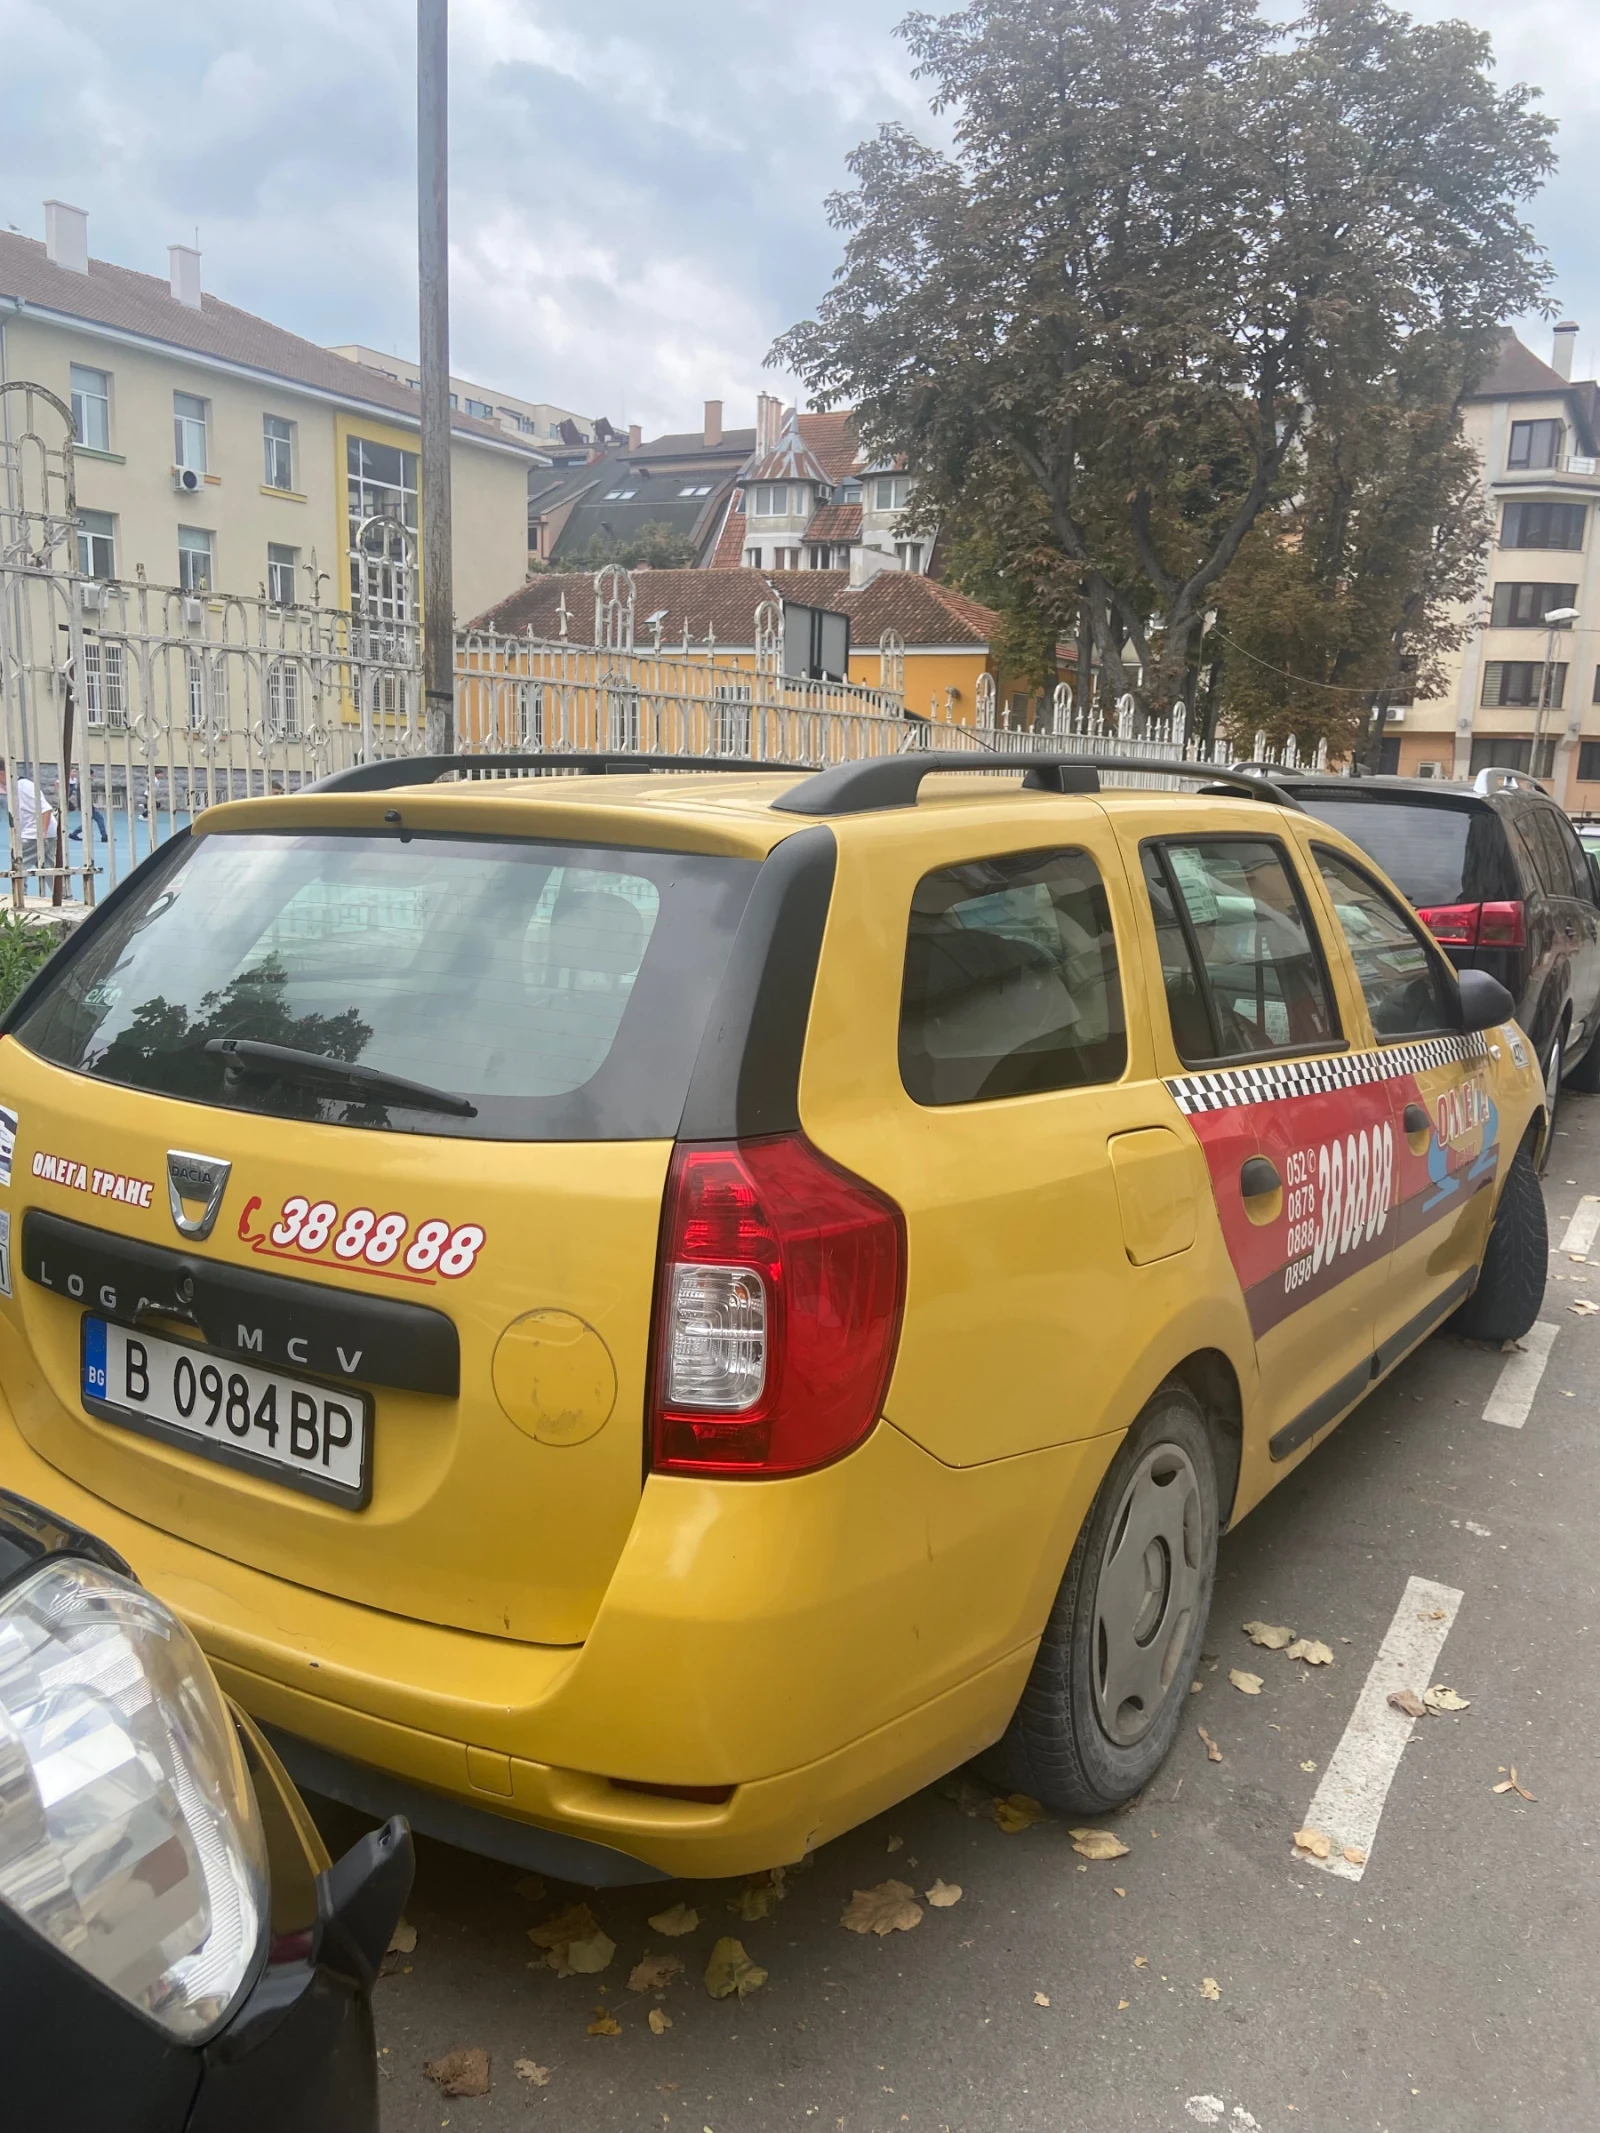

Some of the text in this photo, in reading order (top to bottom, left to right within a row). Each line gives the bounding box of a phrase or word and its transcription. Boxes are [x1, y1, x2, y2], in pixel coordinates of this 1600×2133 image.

[32, 1151, 155, 1208] ОМЕГА ТРАНС
[171, 1165, 213, 1186] DACIA
[1286, 1151, 1307, 1186] 052
[1287, 1183, 1315, 1223] 0878
[270, 1195, 486, 1279] 38 88 88
[1287, 1218, 1315, 1258] 0888
[1284, 1254, 1312, 1294] 0898
[89, 1366, 105, 1386] BG
